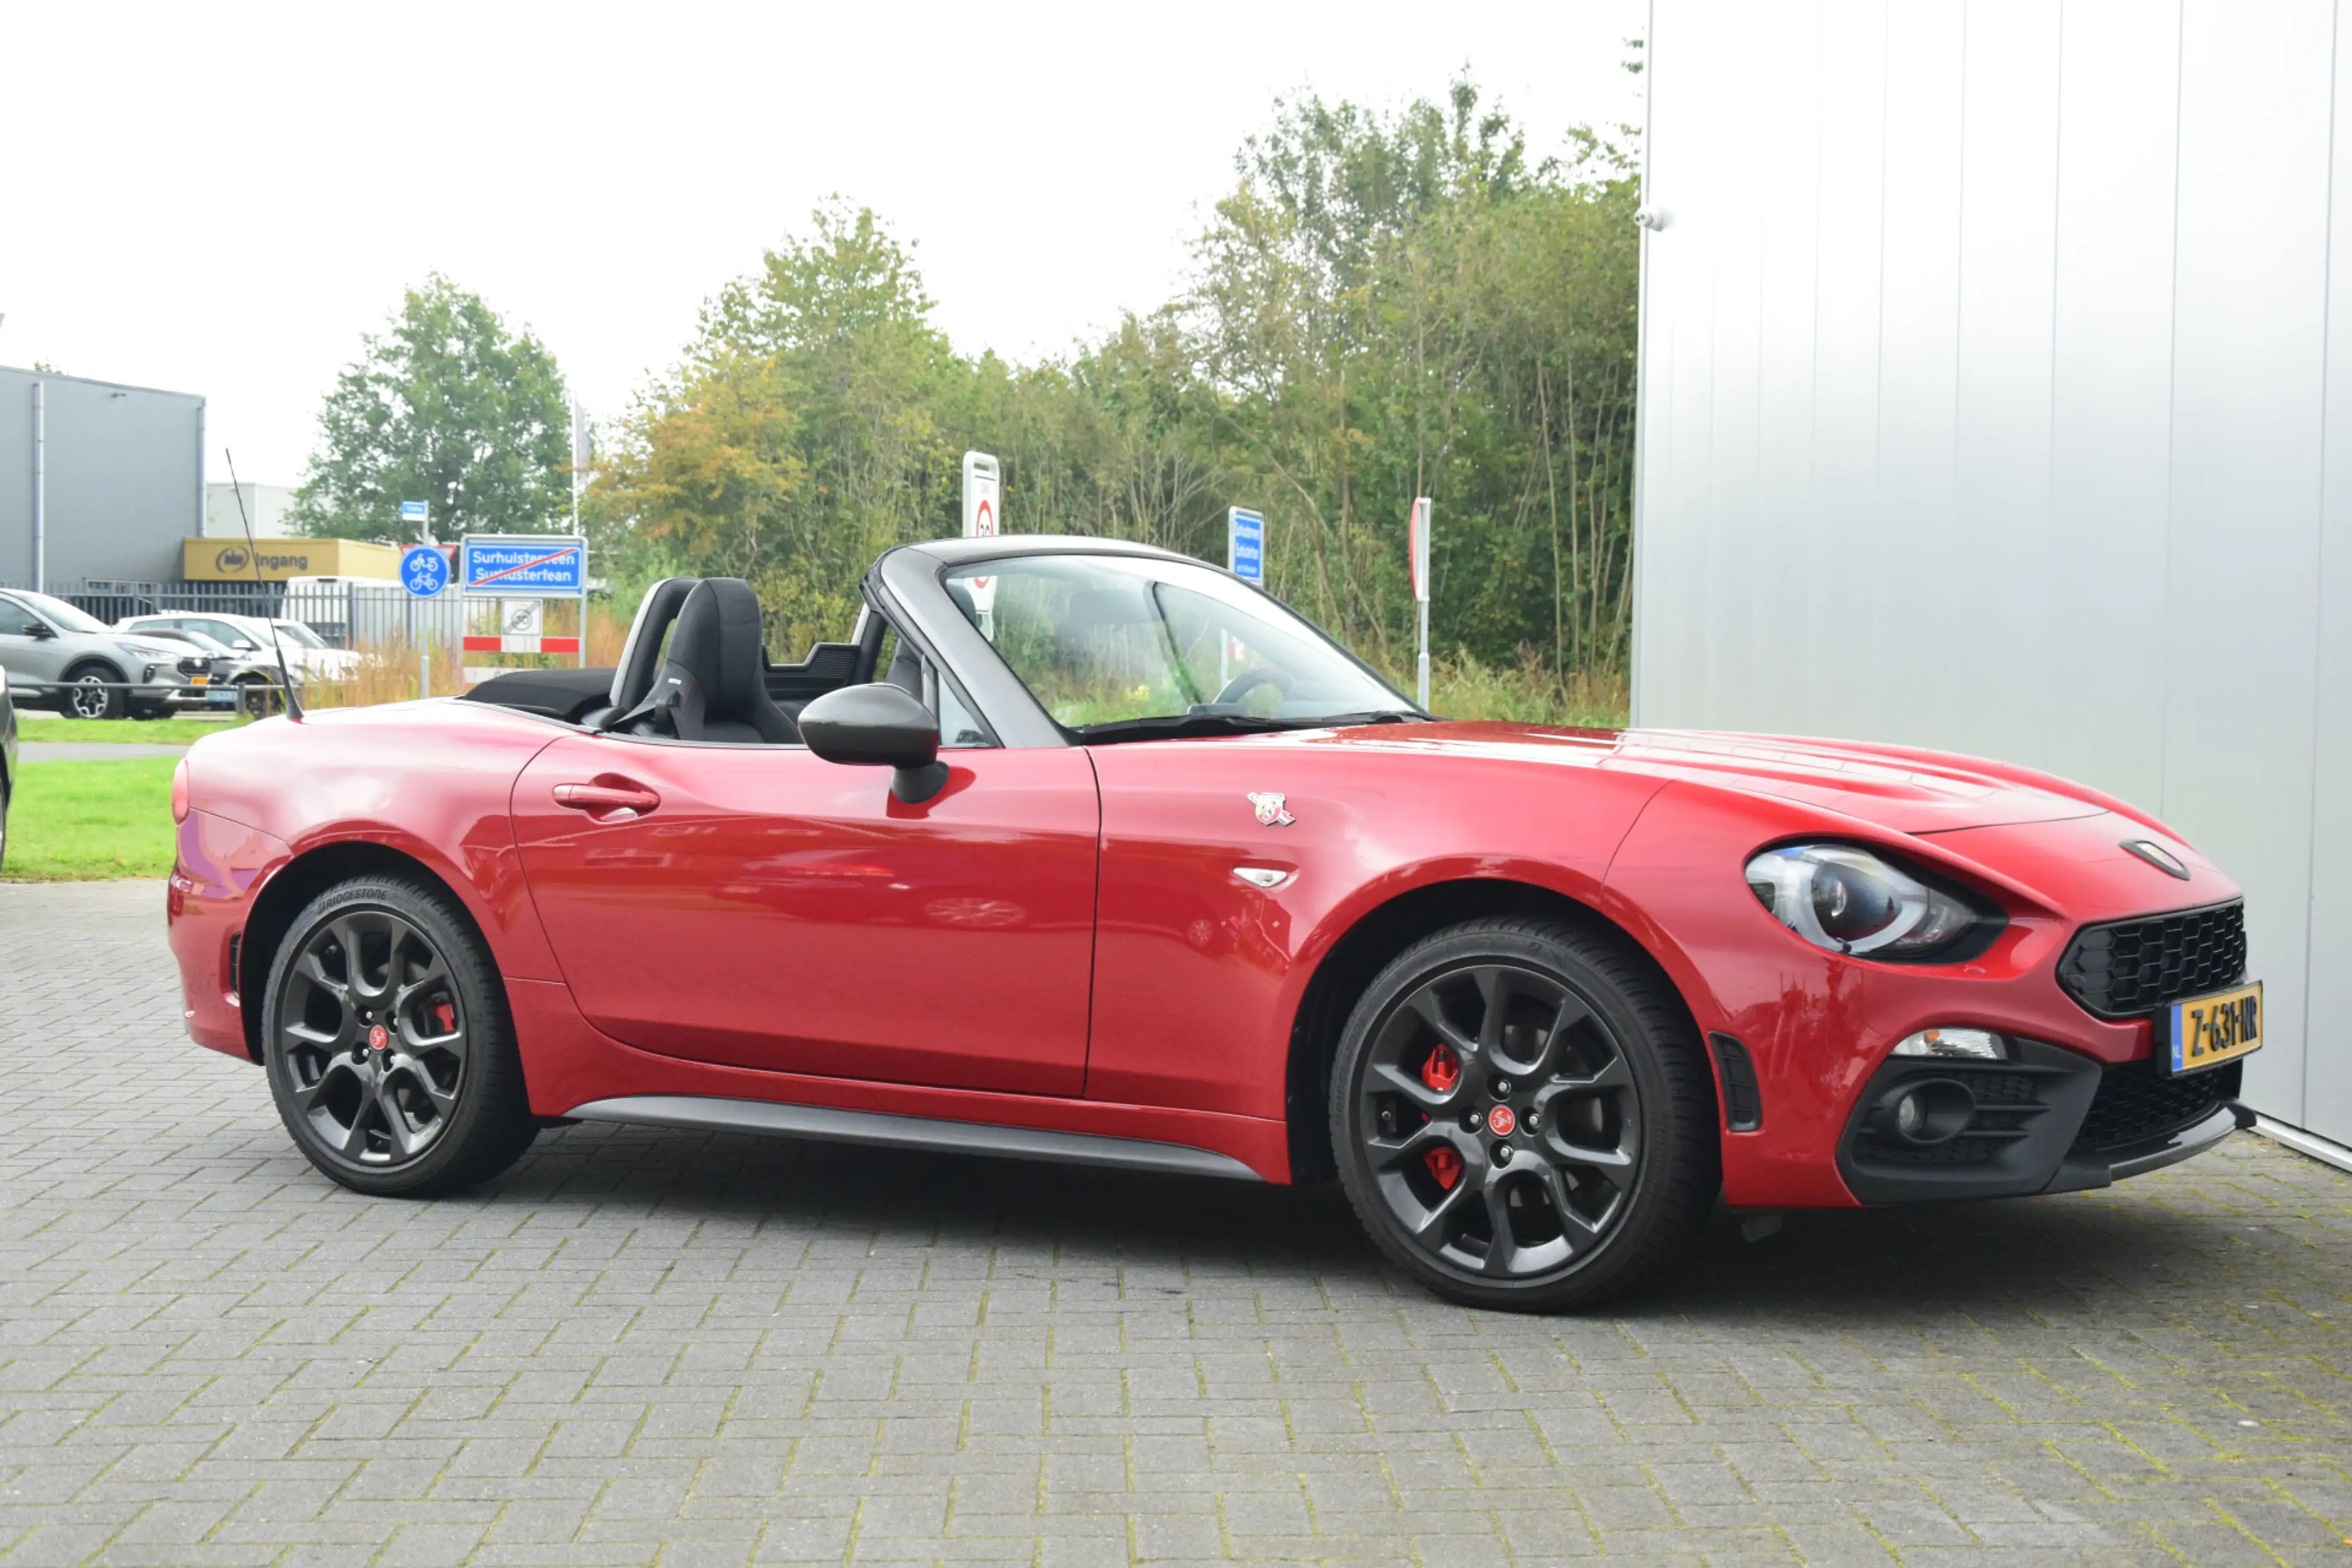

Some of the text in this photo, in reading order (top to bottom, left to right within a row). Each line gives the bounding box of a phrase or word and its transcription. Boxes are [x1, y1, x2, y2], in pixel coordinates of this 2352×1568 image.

[255, 552, 308, 570] Ingang
[318, 889, 387, 913] BRIDGESTONE
[2190, 995, 2258, 1057] Z-631-NR
